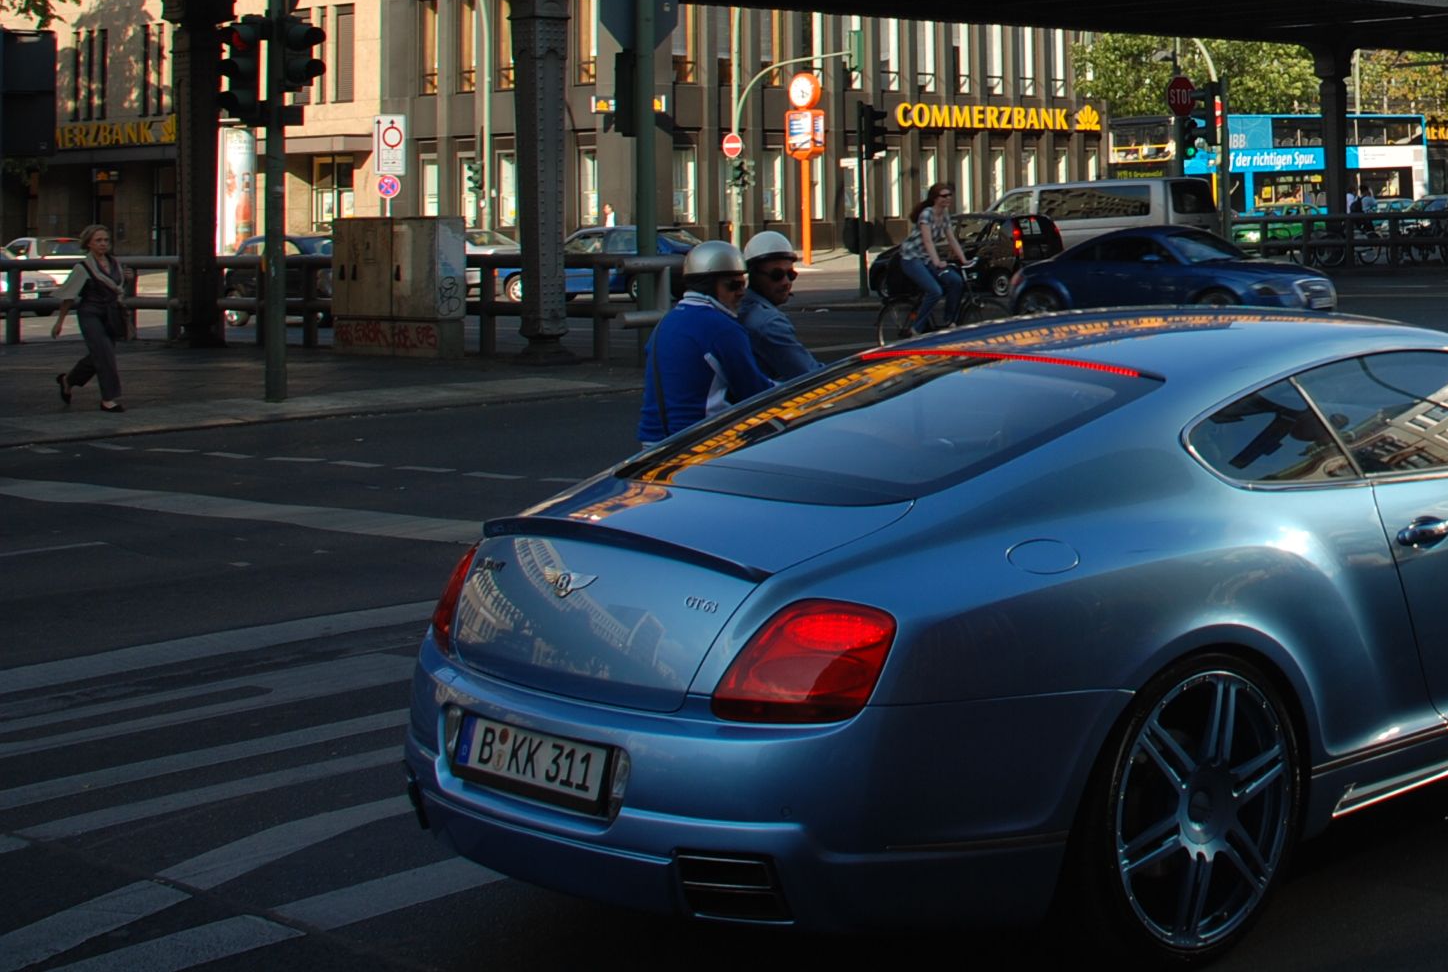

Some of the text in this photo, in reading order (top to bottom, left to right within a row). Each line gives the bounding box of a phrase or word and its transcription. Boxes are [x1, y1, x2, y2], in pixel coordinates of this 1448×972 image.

[896, 102, 1069, 130] COMMERZBANK
[1236, 152, 1251, 167] der
[1253, 152, 1293, 171] richtigen
[1294, 151, 1317, 169] Spur.
[477, 727, 592, 792] B KK 311
